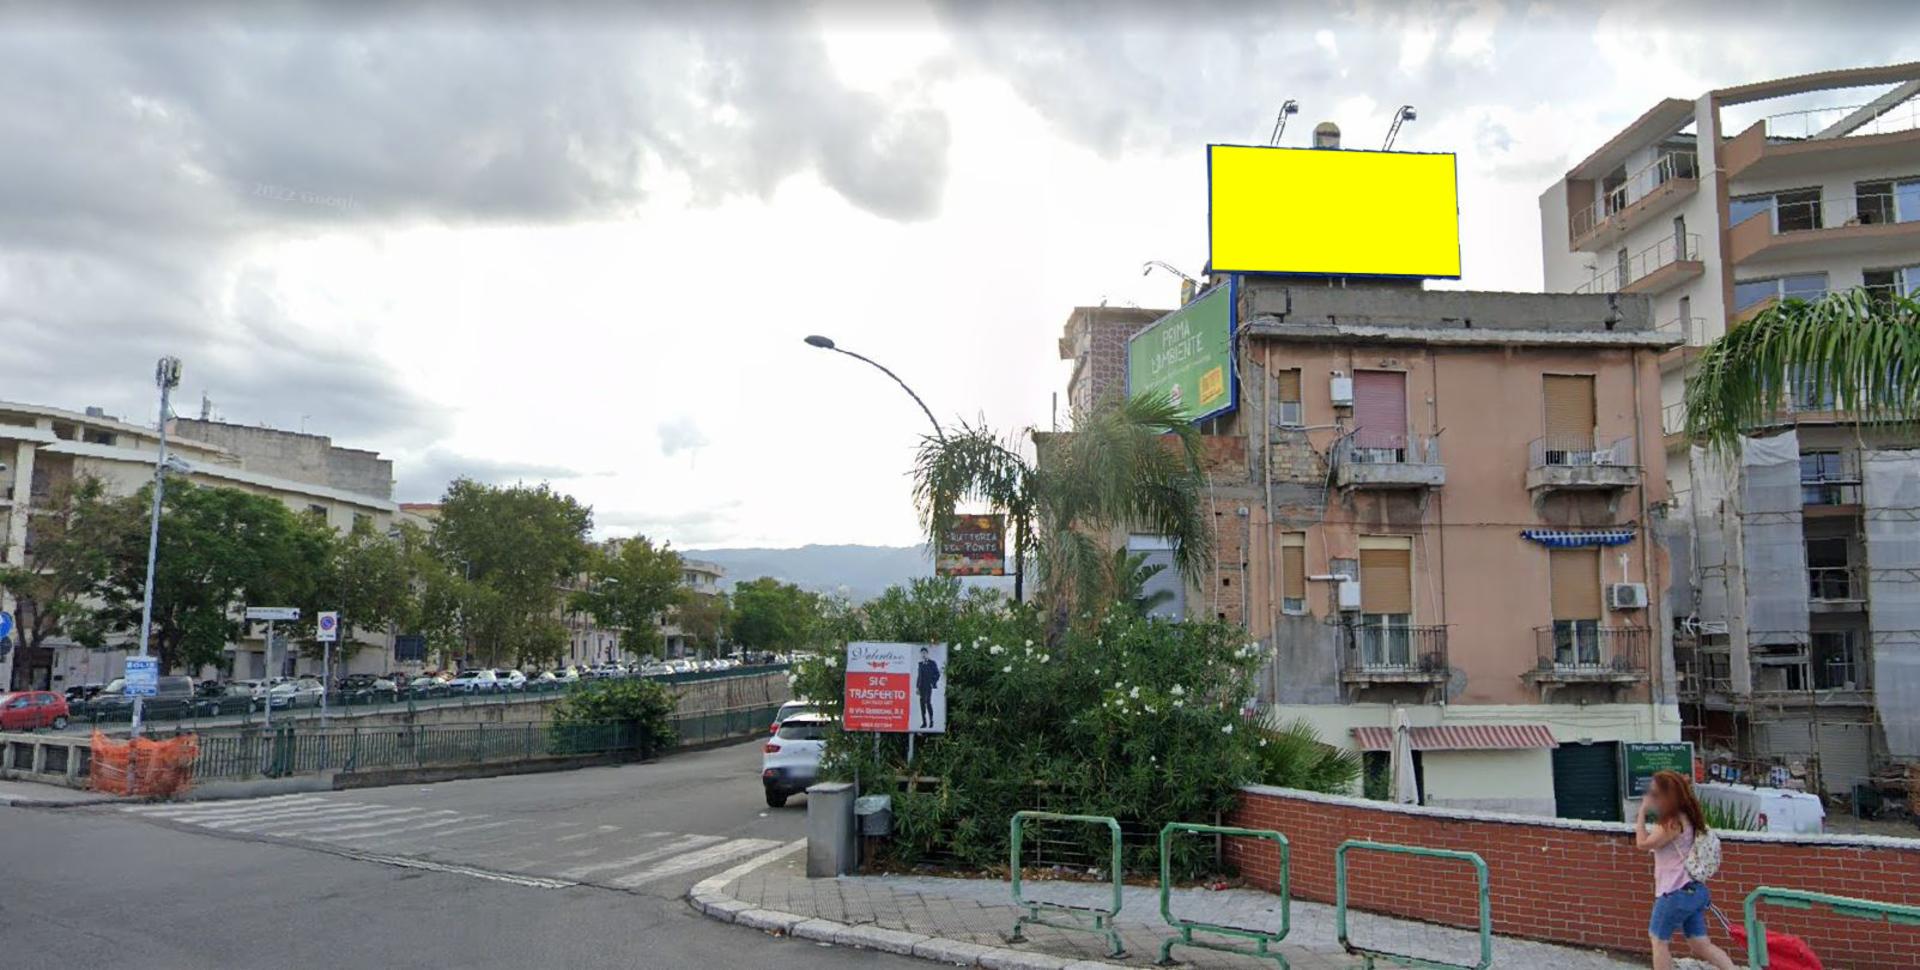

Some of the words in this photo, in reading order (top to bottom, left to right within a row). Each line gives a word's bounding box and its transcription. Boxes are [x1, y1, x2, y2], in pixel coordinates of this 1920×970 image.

[1162, 319, 1191, 348] PRIMA
[1151, 331, 1204, 375] L'AMBIENTE
[964, 542, 997, 552] PONTE
[849, 688, 906, 700] TRASFERITO
